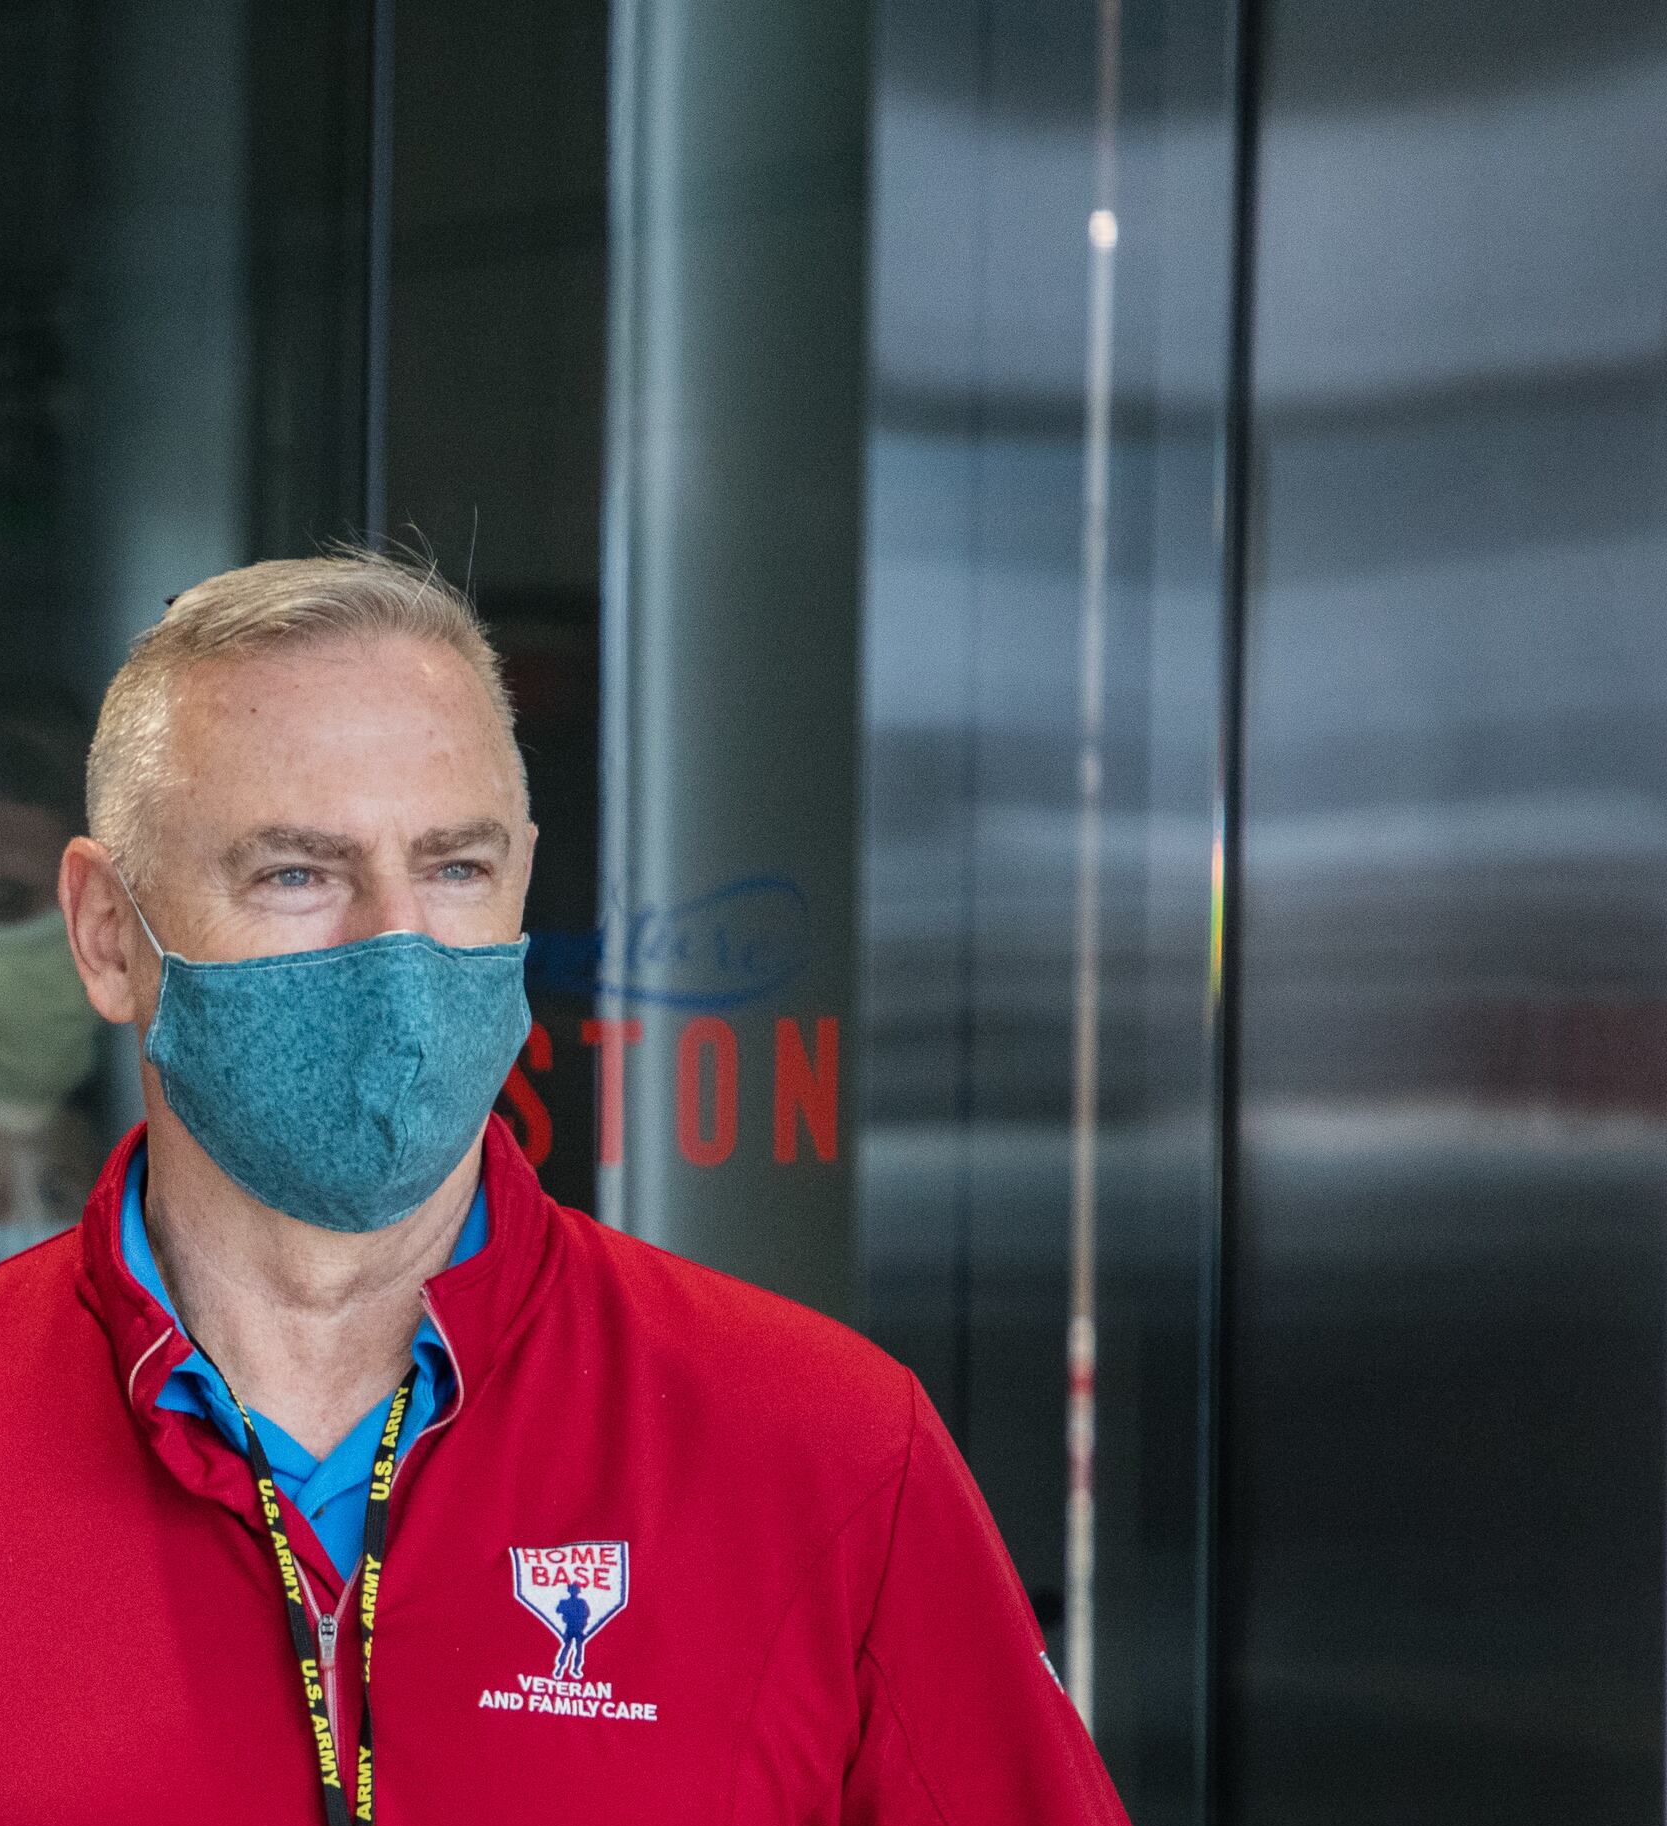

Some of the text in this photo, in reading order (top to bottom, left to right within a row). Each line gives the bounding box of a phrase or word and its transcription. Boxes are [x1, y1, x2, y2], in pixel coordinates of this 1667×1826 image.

[370, 1386, 409, 1501] U.S. ARMY
[258, 1478, 302, 1605] U.S. ARMY
[522, 1547, 617, 1566] HOME
[532, 1566, 611, 1590] BASE
[361, 1553, 382, 1630] ARMY
[301, 1659, 341, 1789] U.S. ARMY
[478, 1690, 658, 1722] AND FAMILY CARE
[517, 1674, 612, 1699] VETERAN
[356, 1746, 373, 1821] ARMY
